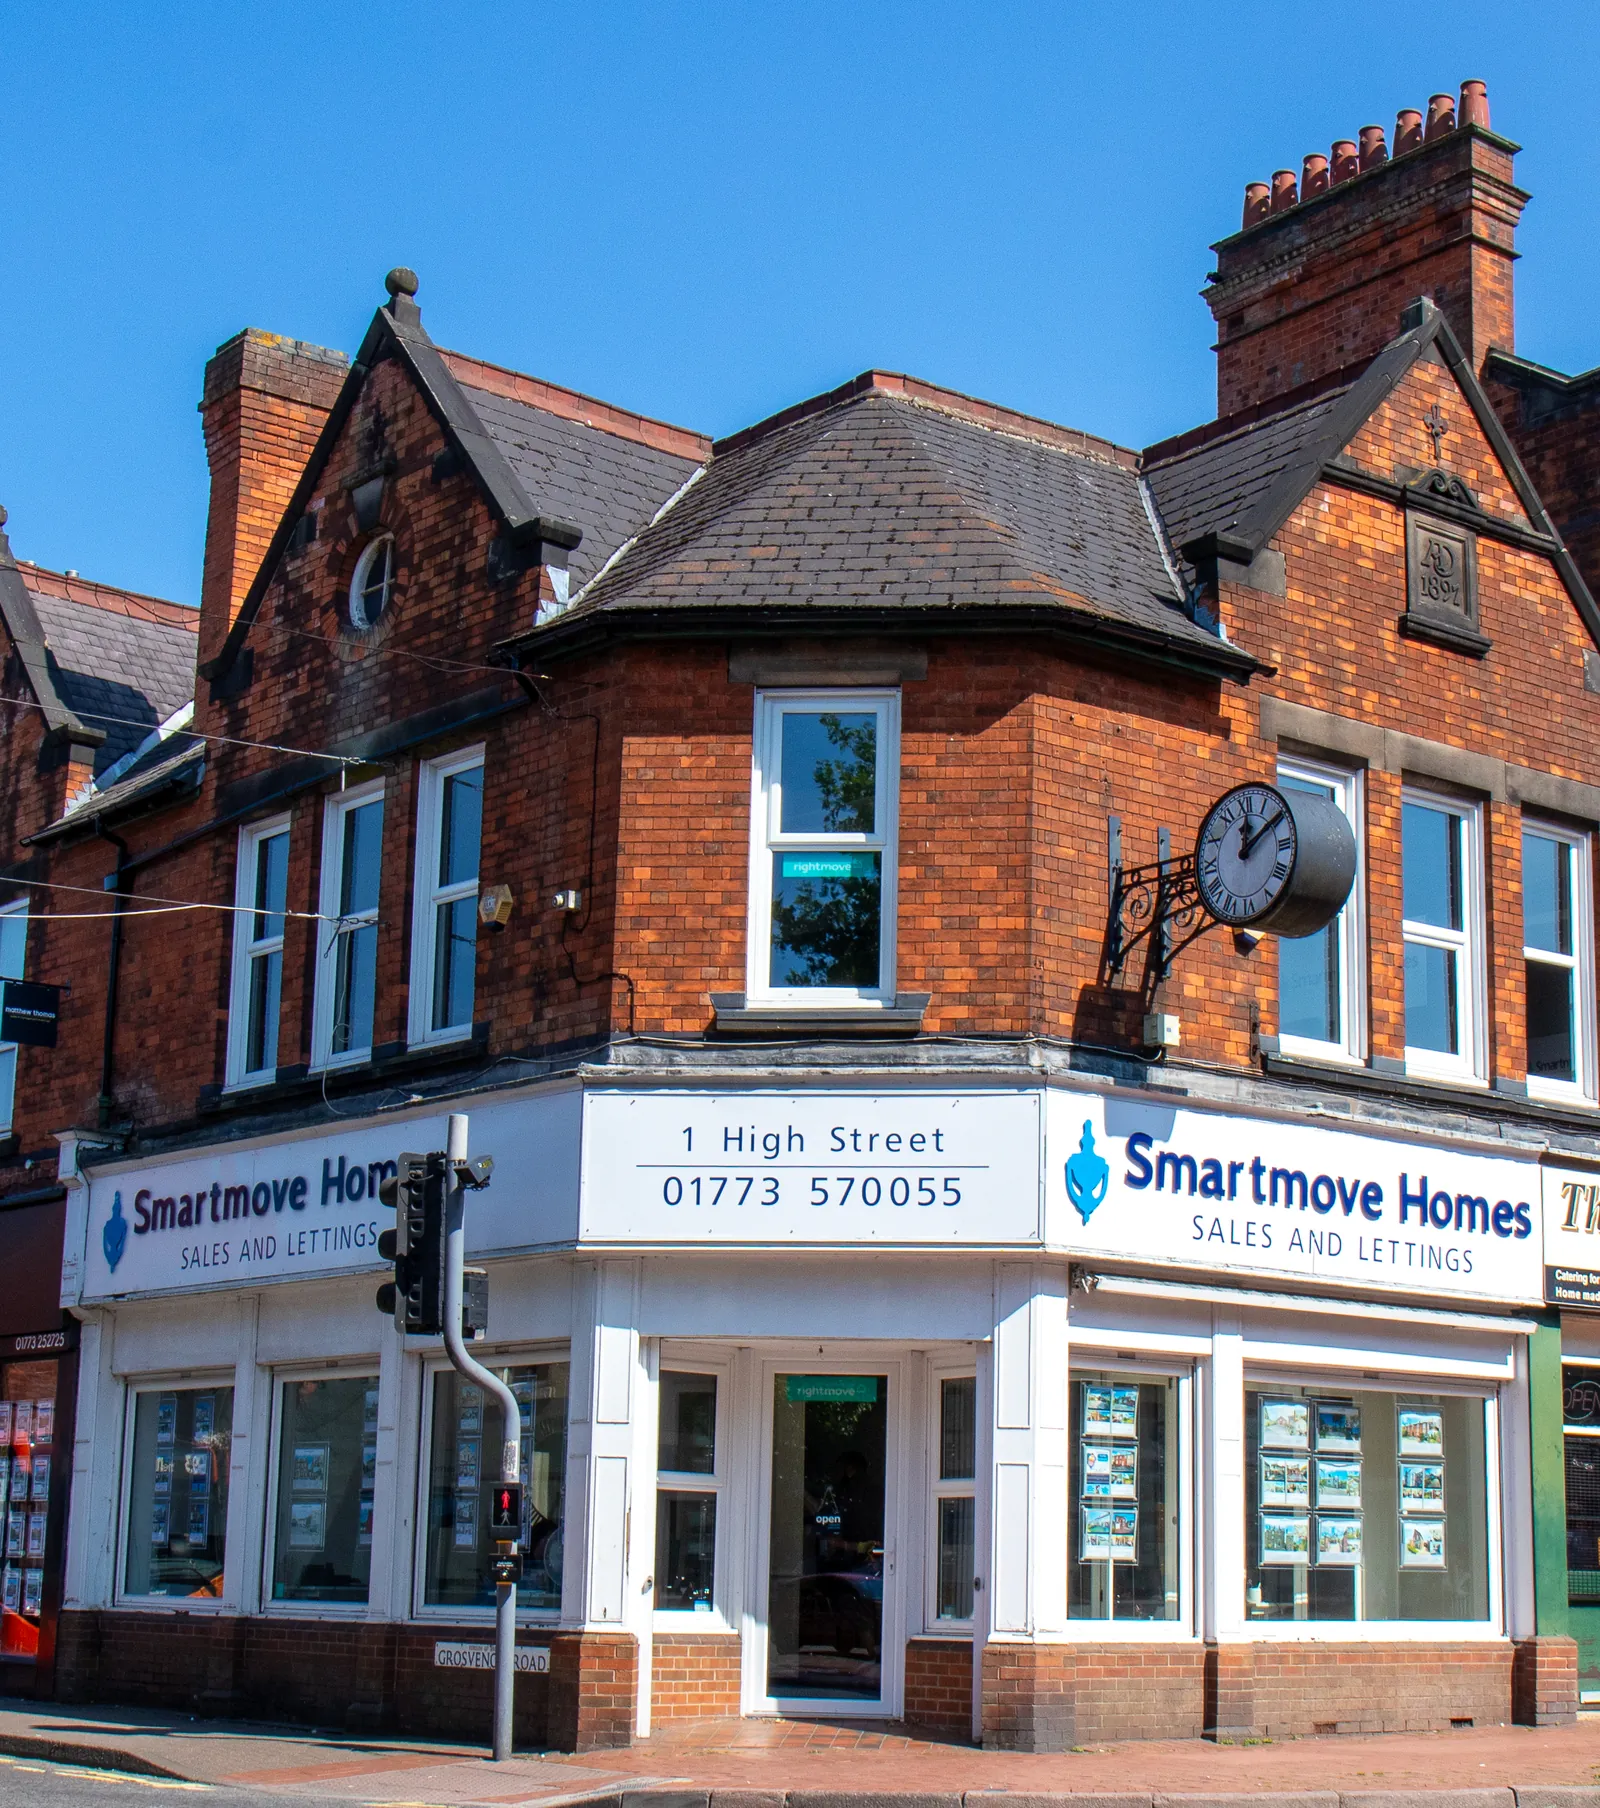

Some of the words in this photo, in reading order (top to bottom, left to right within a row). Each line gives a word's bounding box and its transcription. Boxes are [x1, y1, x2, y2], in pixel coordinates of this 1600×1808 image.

[793, 861, 852, 873] rightmove
[683, 1126, 693, 1152] 1
[723, 1124, 805, 1160] High
[829, 1126, 945, 1153] Street
[133, 1174, 308, 1235] Smartmove
[320, 1155, 398, 1206] Hom
[662, 1176, 781, 1206] 01773
[810, 1176, 963, 1206] 570055
[1124, 1131, 1384, 1222] Smartmove
[1398, 1171, 1533, 1240] Homes
[181, 1241, 231, 1270] SALES
[239, 1235, 277, 1263] AND
[287, 1221, 378, 1257] LETTINGS
[1192, 1214, 1273, 1249] SALES
[1289, 1227, 1343, 1257] AND
[1358, 1235, 1474, 1274] LETTINGS
[1555, 1269, 1588, 1286] Catering
[1555, 1286, 1581, 1300] Home
[16, 1336, 37, 1350] 01773
[37, 1332, 65, 1348] 252725
[797, 1385, 855, 1398] rightmove
[815, 1515, 841, 1526] open
[438, 1649, 496, 1669] GROSVENO
[514, 1653, 546, 1671] ROAD
